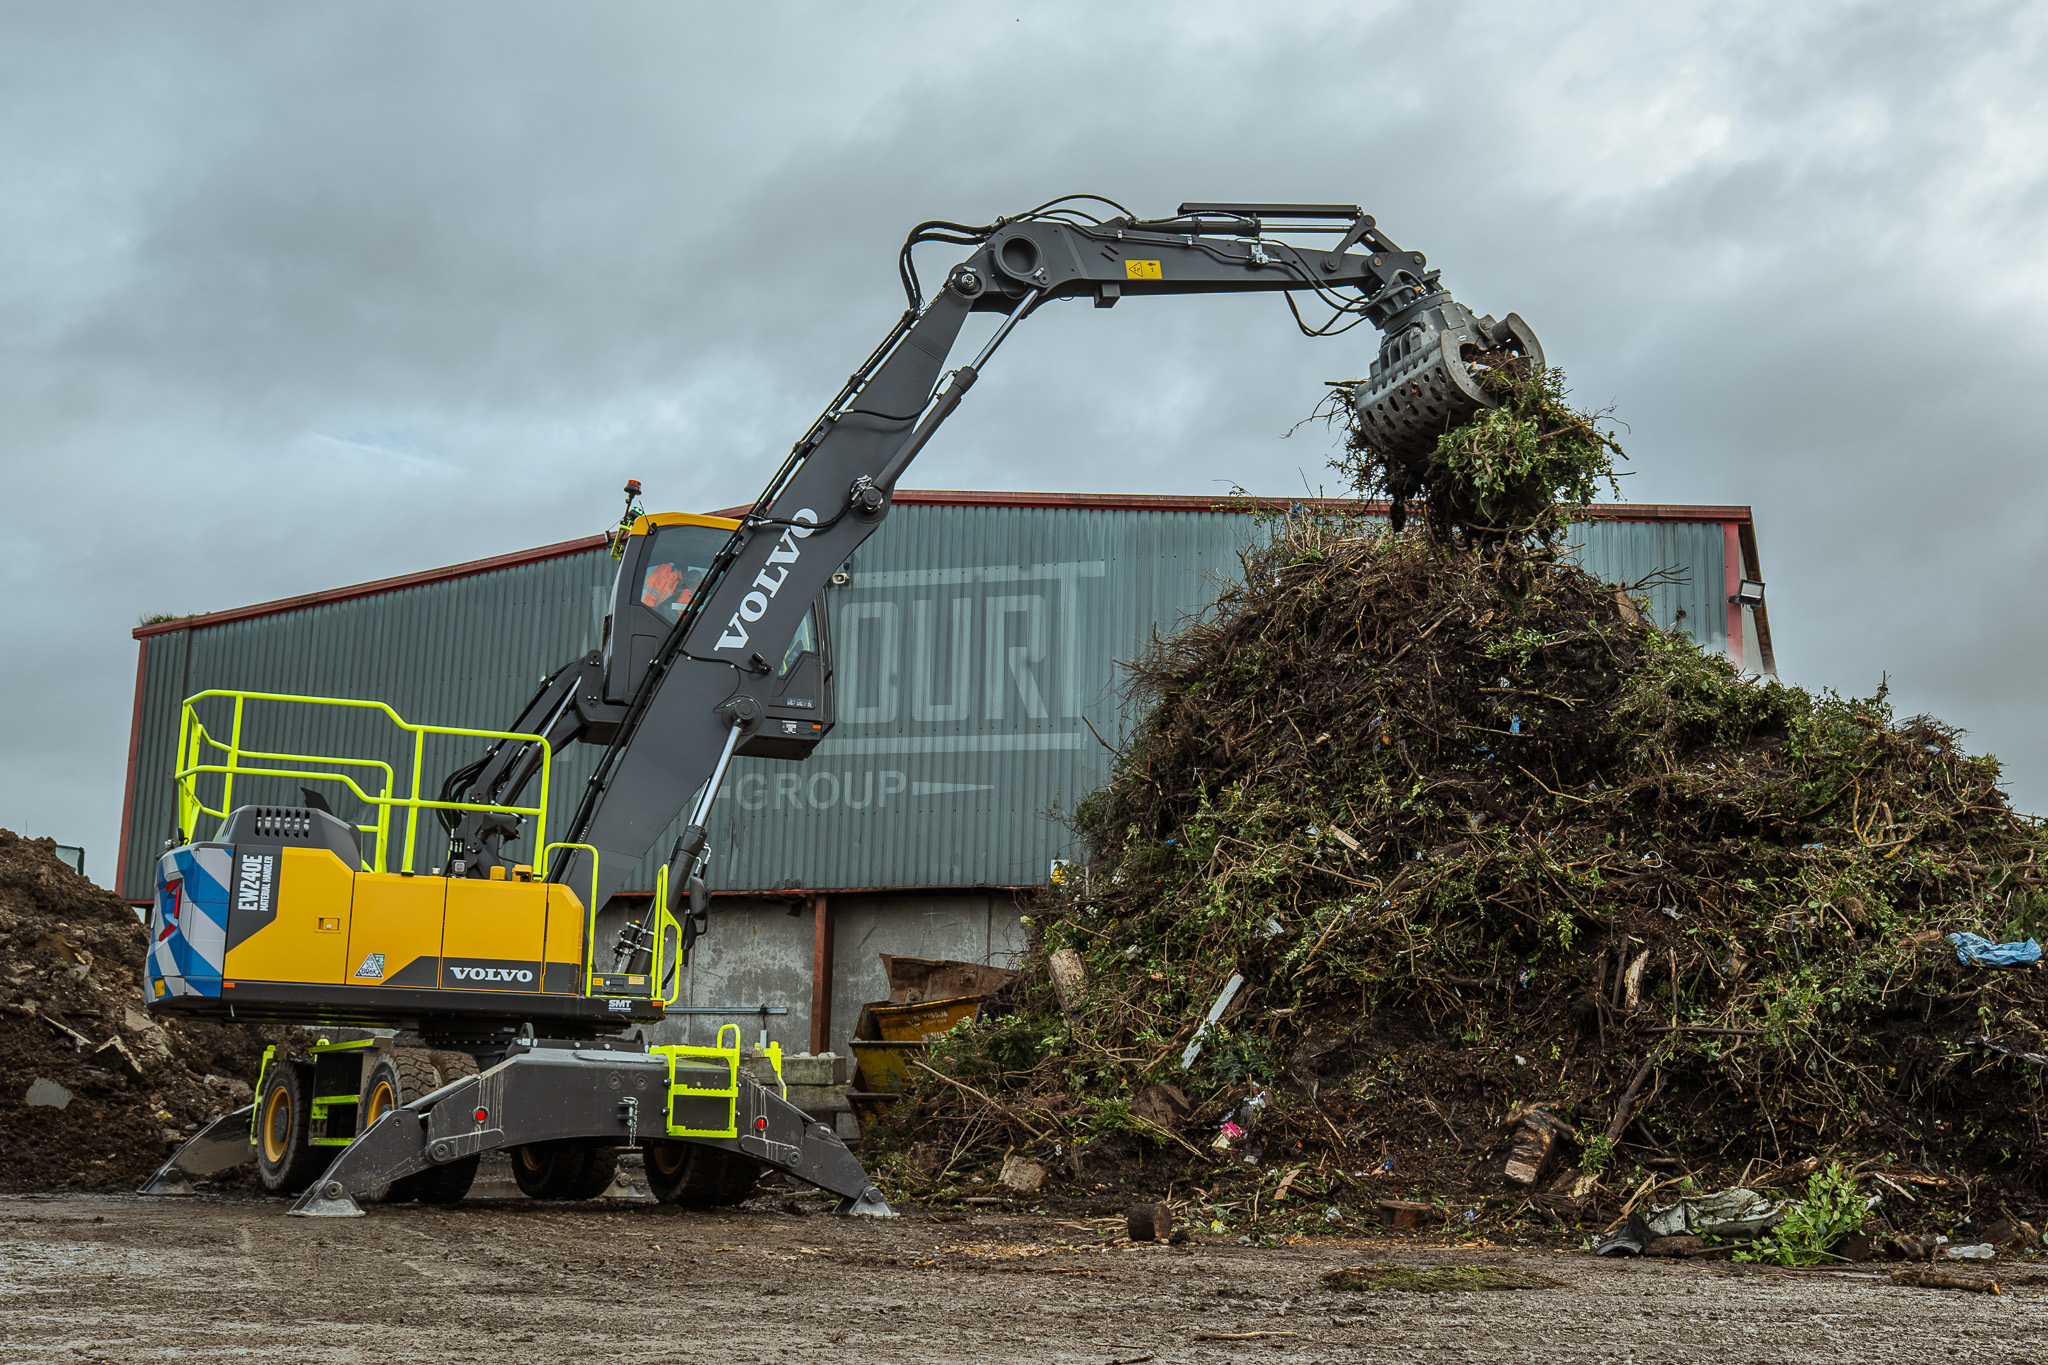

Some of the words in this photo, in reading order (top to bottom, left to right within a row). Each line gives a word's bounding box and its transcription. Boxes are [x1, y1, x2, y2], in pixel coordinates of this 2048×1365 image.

[713, 508, 819, 652] VOLVO
[838, 560, 1105, 725] OURT
[735, 770, 908, 811] GROUP
[238, 854, 263, 911] EW240E
[262, 855, 274, 883] HANDLER
[259, 883, 271, 912] MATERIAL
[450, 967, 533, 983] VOLVO
[608, 999, 632, 1008] SMT
